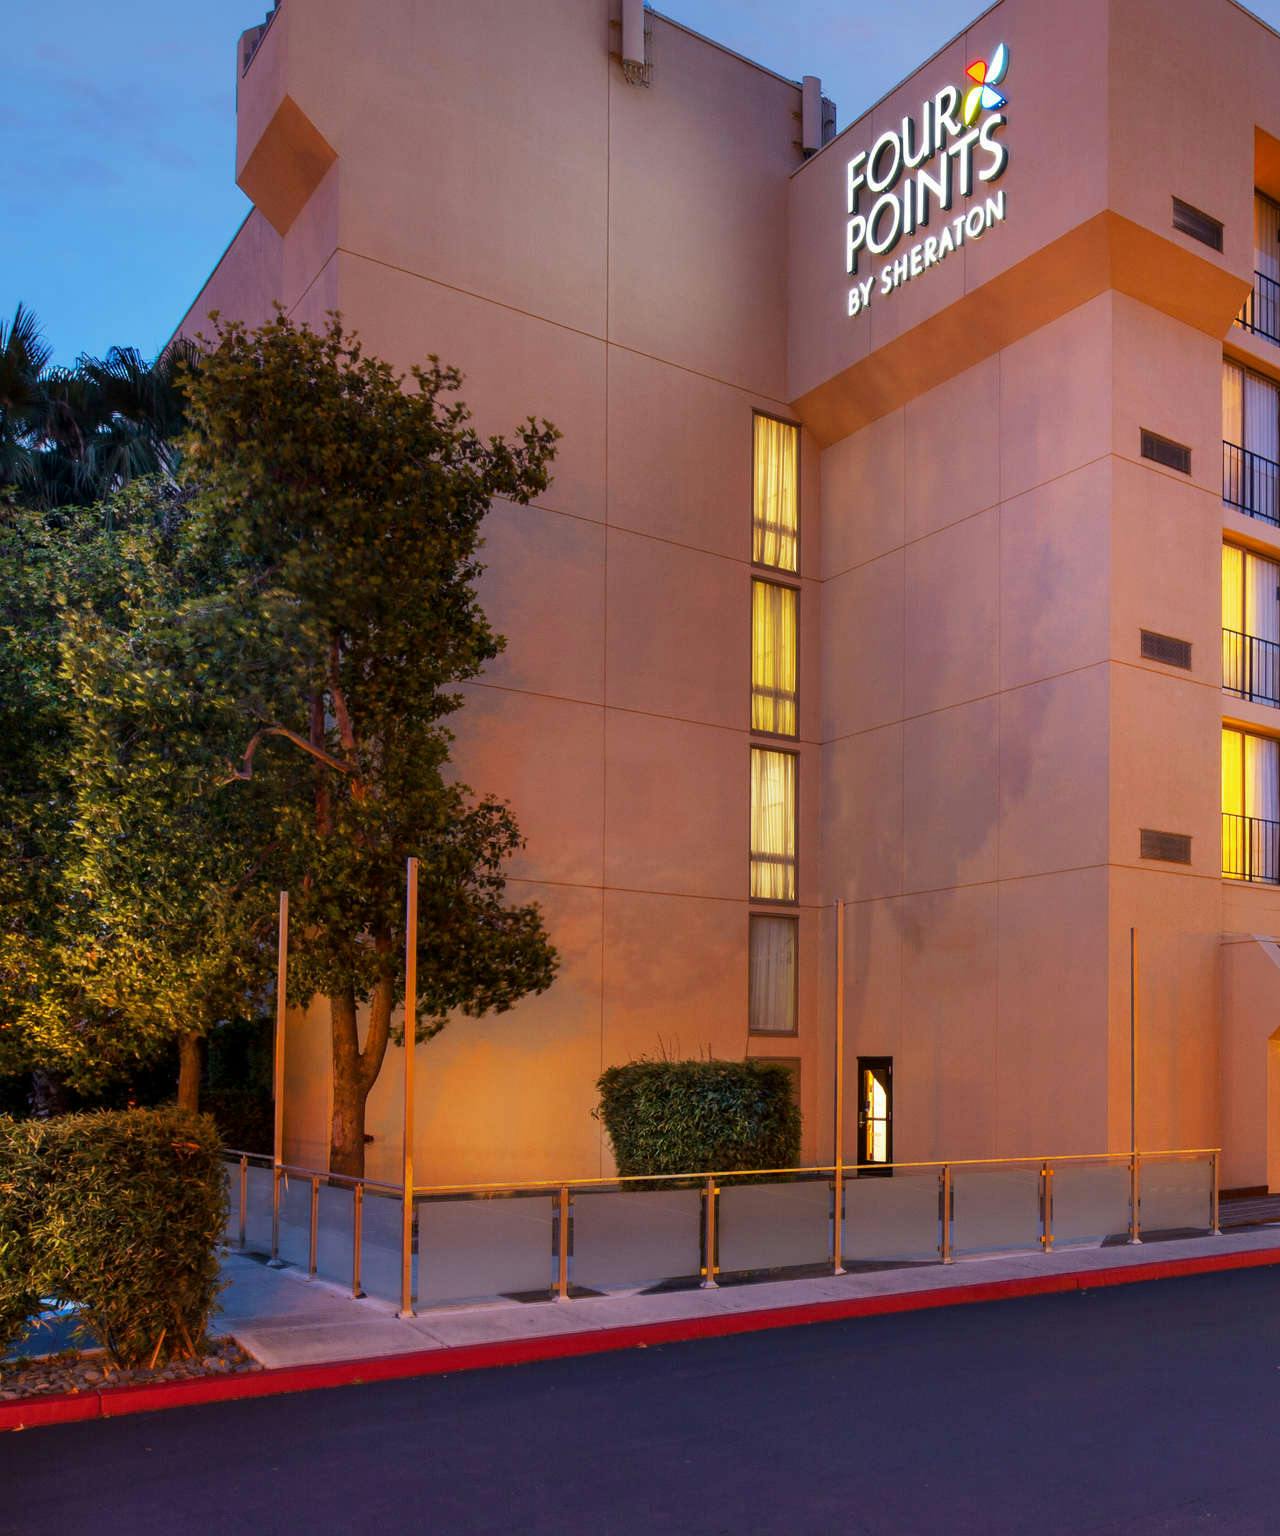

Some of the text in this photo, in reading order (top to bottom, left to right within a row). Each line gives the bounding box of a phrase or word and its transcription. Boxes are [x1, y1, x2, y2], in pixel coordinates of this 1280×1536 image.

[847, 86, 961, 213] FOUR
[847, 114, 1007, 274] POINTS
[848, 191, 1006, 316] BY SHERATON
